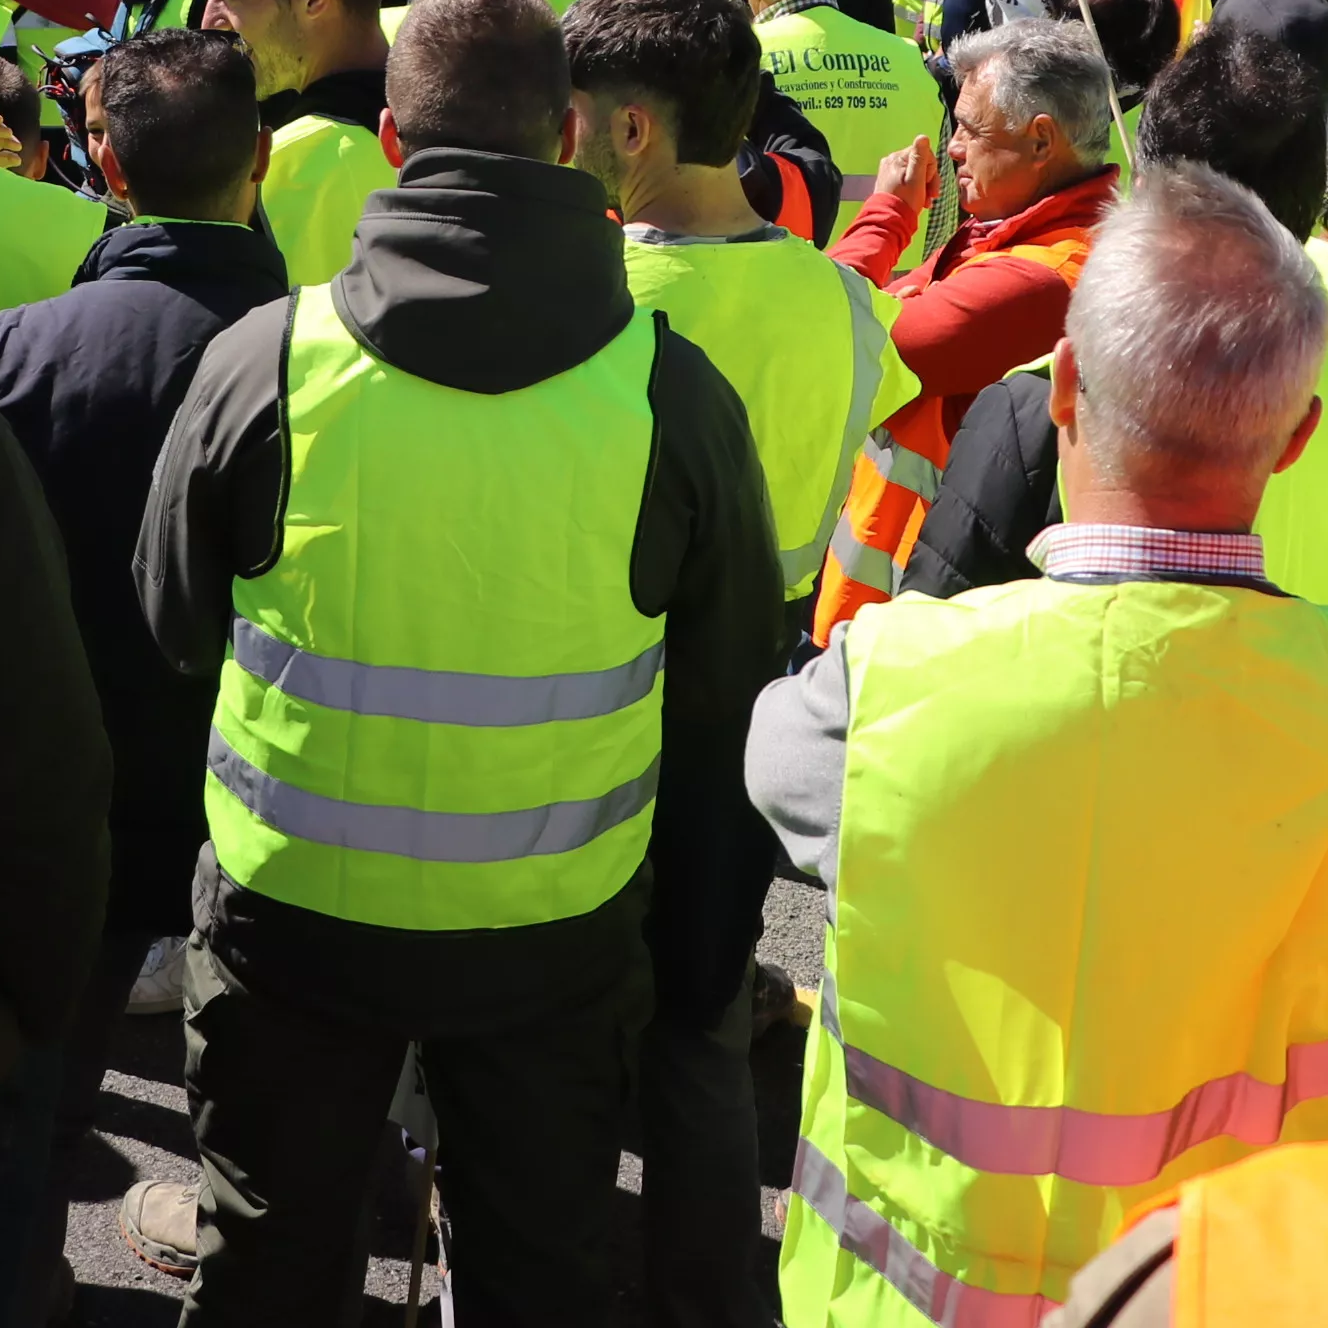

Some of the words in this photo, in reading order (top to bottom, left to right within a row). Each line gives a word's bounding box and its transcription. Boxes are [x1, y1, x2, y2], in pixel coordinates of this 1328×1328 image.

[770, 49, 796, 75] El
[803, 48, 891, 77] Compae
[830, 82, 835, 93] y
[837, 78, 900, 92] Construcciones
[825, 96, 843, 109] 629
[848, 96, 866, 109] 709
[869, 96, 888, 109] 534
